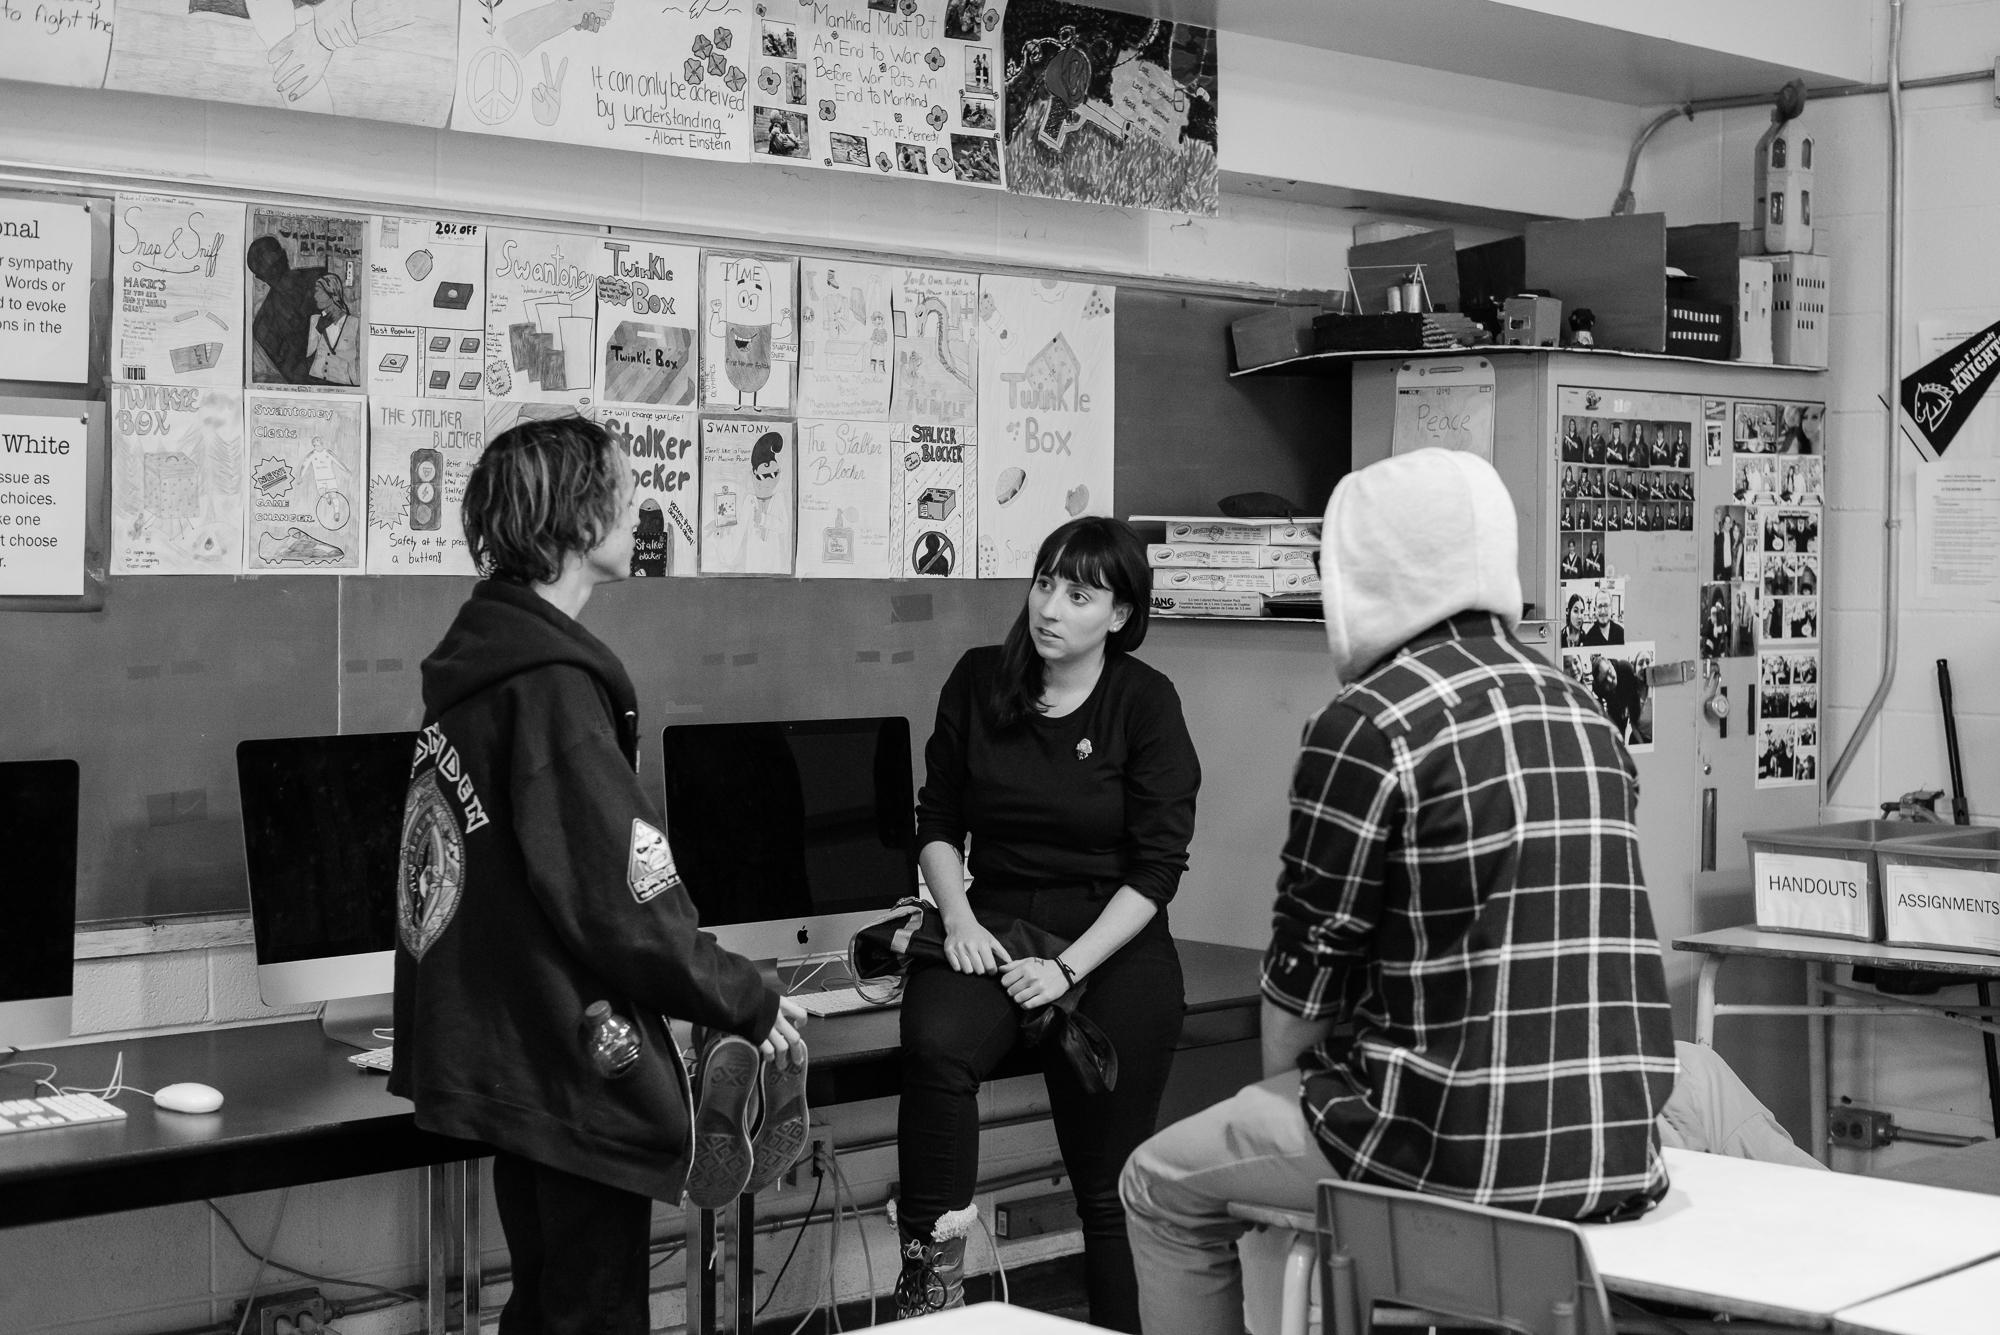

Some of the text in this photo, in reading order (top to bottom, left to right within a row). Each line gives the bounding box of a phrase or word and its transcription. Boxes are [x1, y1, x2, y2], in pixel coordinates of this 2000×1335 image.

[1, 3, 113, 34] to fight the
[878, 12, 912, 37] Must
[915, 14, 937, 39] Put
[813, 34, 920, 64] An End to War
[814, 57, 937, 89] Before War Puts An
[592, 66, 604, 91] It
[608, 70, 634, 93] can
[638, 75, 668, 110] only
[671, 79, 687, 99] be
[834, 83, 856, 104] End
[868, 88, 881, 104] to
[596, 93, 616, 130] by
[688, 134, 731, 150] Einstein
[435, 221, 478, 235] 20% OFF
[119, 206, 225, 278] Snap & Sniff
[8, 257, 73, 275] sympathy
[720, 262, 761, 282] TIME
[5, 274, 65, 291] Words or
[9, 298, 22, 310] to
[26, 300, 66, 313] evoke
[632, 280, 676, 315] Box
[23, 319, 35, 332] in
[40, 321, 62, 334] the
[370, 326, 416, 337] Most Popular
[1969, 331, 1996, 357] Kennedy
[654, 349, 678, 370] Box
[254, 404, 334, 420] Swantoney
[381, 407, 462, 430] THE STALKER
[632, 411, 653, 421] change
[654, 413, 668, 421] your
[1417, 404, 1470, 432] Peace
[115, 409, 171, 436] BOX
[254, 426, 298, 439] Cleats
[706, 422, 769, 433] SWANTONY
[2, 434, 70, 455] White
[432, 430, 482, 449] BLOCKER
[605, 418, 692, 460] Stalker
[802, 422, 882, 456] The Stalker
[911, 425, 956, 445] STALKER
[1025, 417, 1072, 457] Box
[921, 444, 964, 464] BLOCKER
[34, 473, 50, 484] as
[258, 466, 287, 485] NEW!
[0, 491, 56, 505] choices.
[445, 487, 464, 495] Stalker
[256, 499, 289, 507] GAME
[15, 515, 41, 525] one
[9, 533, 58, 547] choose
[389, 532, 417, 552] Safety
[422, 537, 430, 546] at
[436, 536, 447, 547] the
[635, 538, 664, 550] Stalker
[392, 555, 399, 564] a
[1769, 875, 1858, 899] HANDOUTS
[1897, 893, 2000, 916] ASSIGNMENTS
